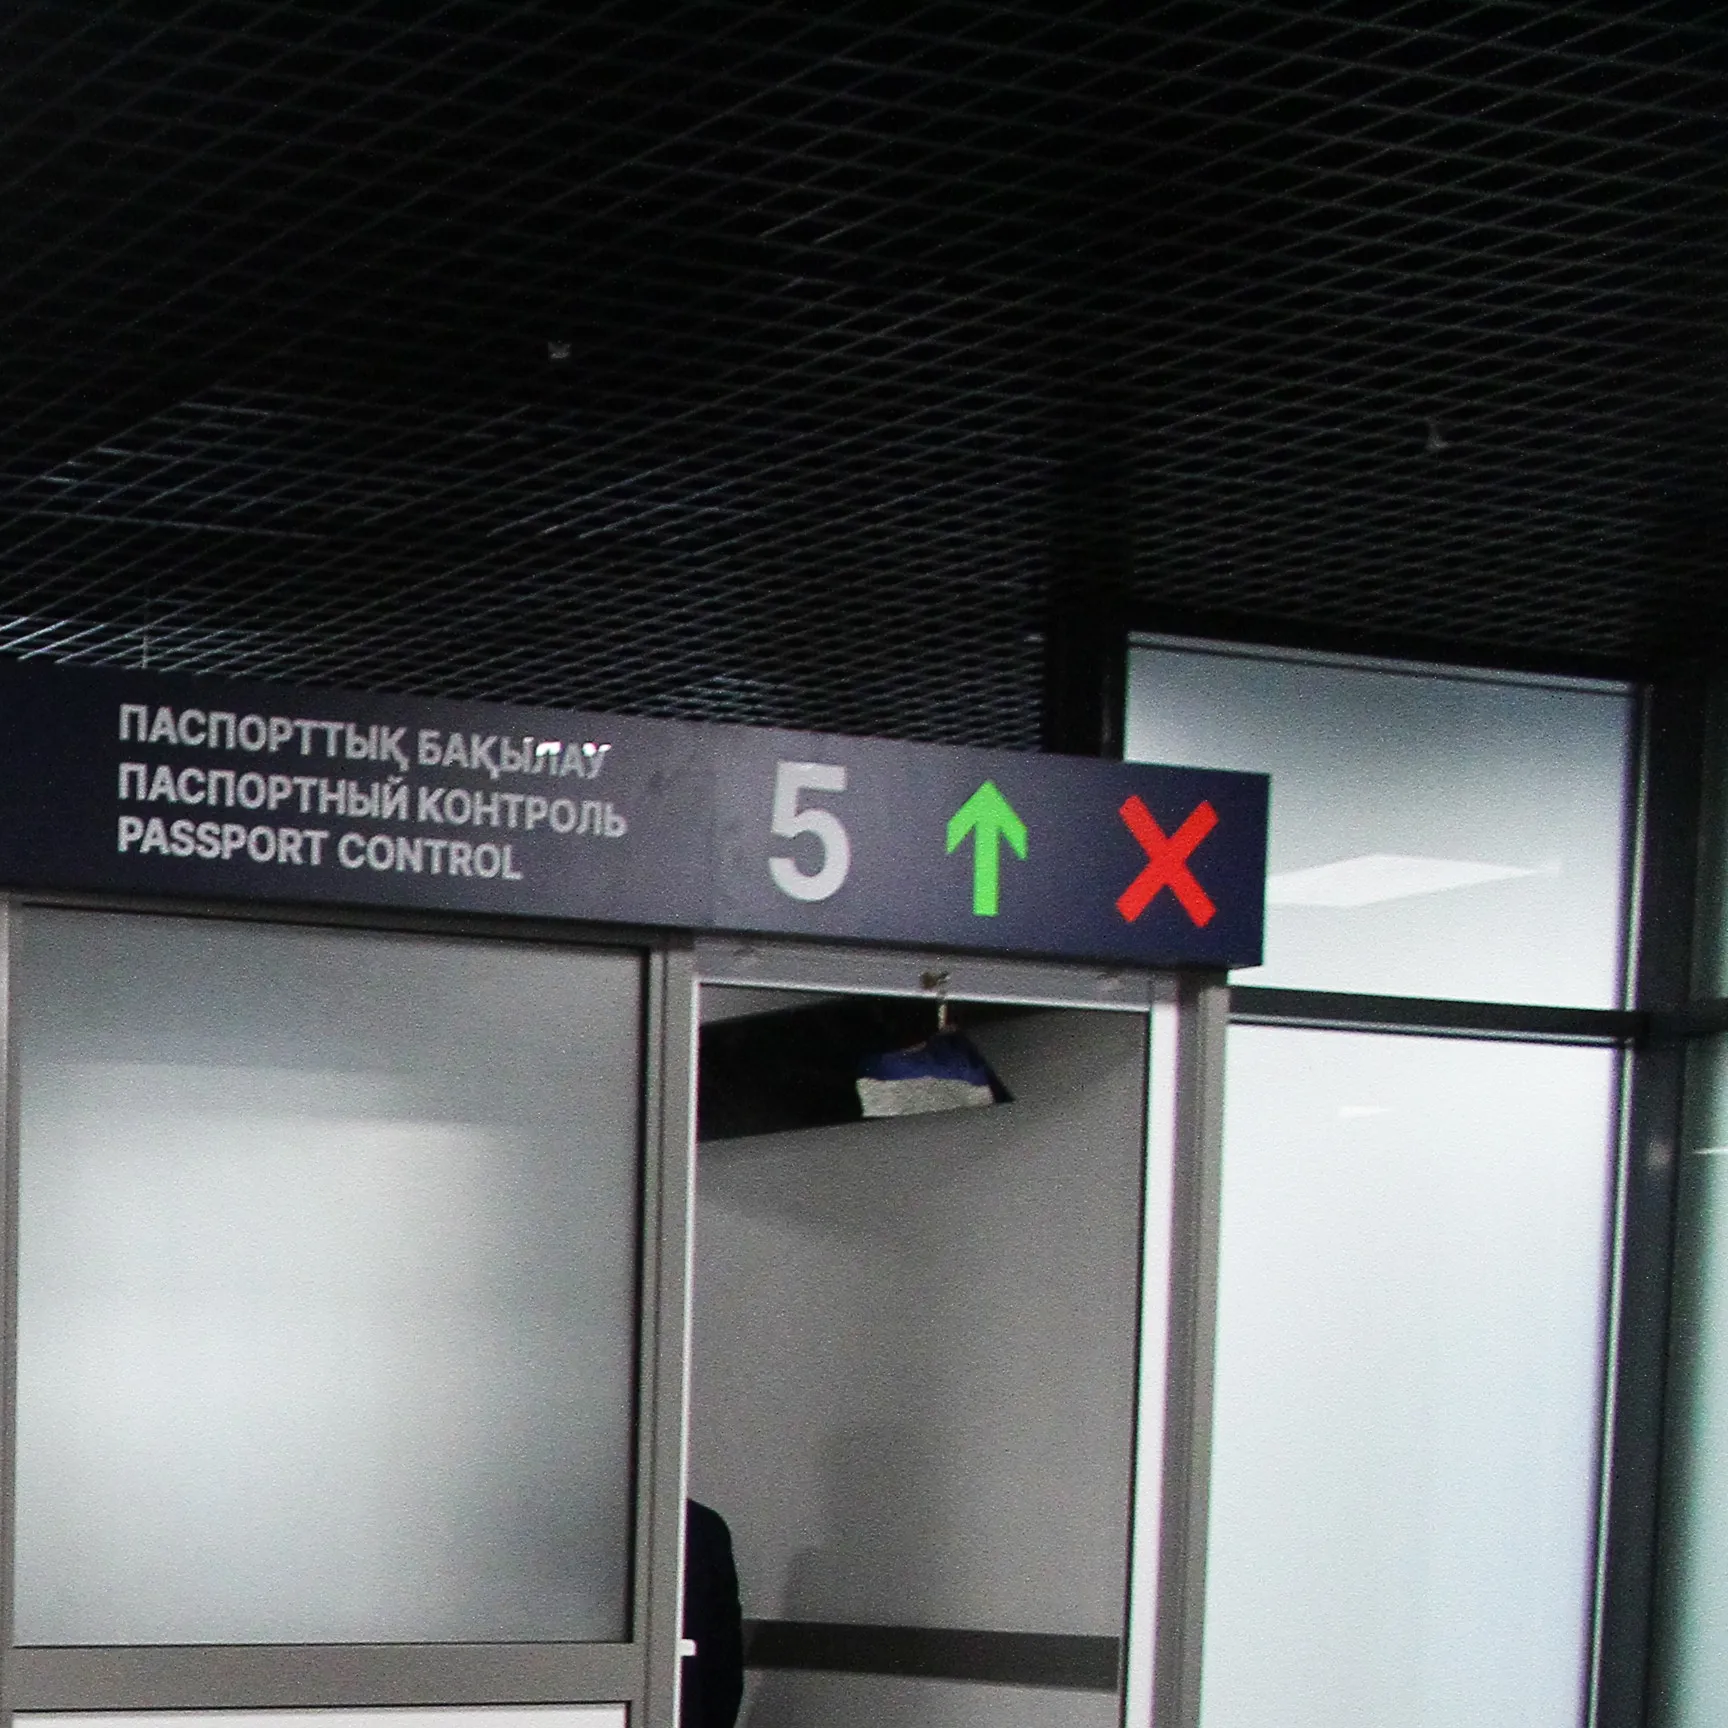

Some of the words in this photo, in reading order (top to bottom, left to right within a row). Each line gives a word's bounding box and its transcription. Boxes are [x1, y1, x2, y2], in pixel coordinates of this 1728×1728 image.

[118, 703, 409, 769] ПАСПОРТТЫҚ
[418, 729, 613, 780] БАҚЫЛАУ
[118, 762, 409, 820] ПАСПОРТНЫЙ
[418, 786, 628, 838] КОНТРОЛЬ
[769, 762, 850, 901] 5
[117, 815, 329, 866] PASSPORT
[337, 832, 523, 881] CONTROL
